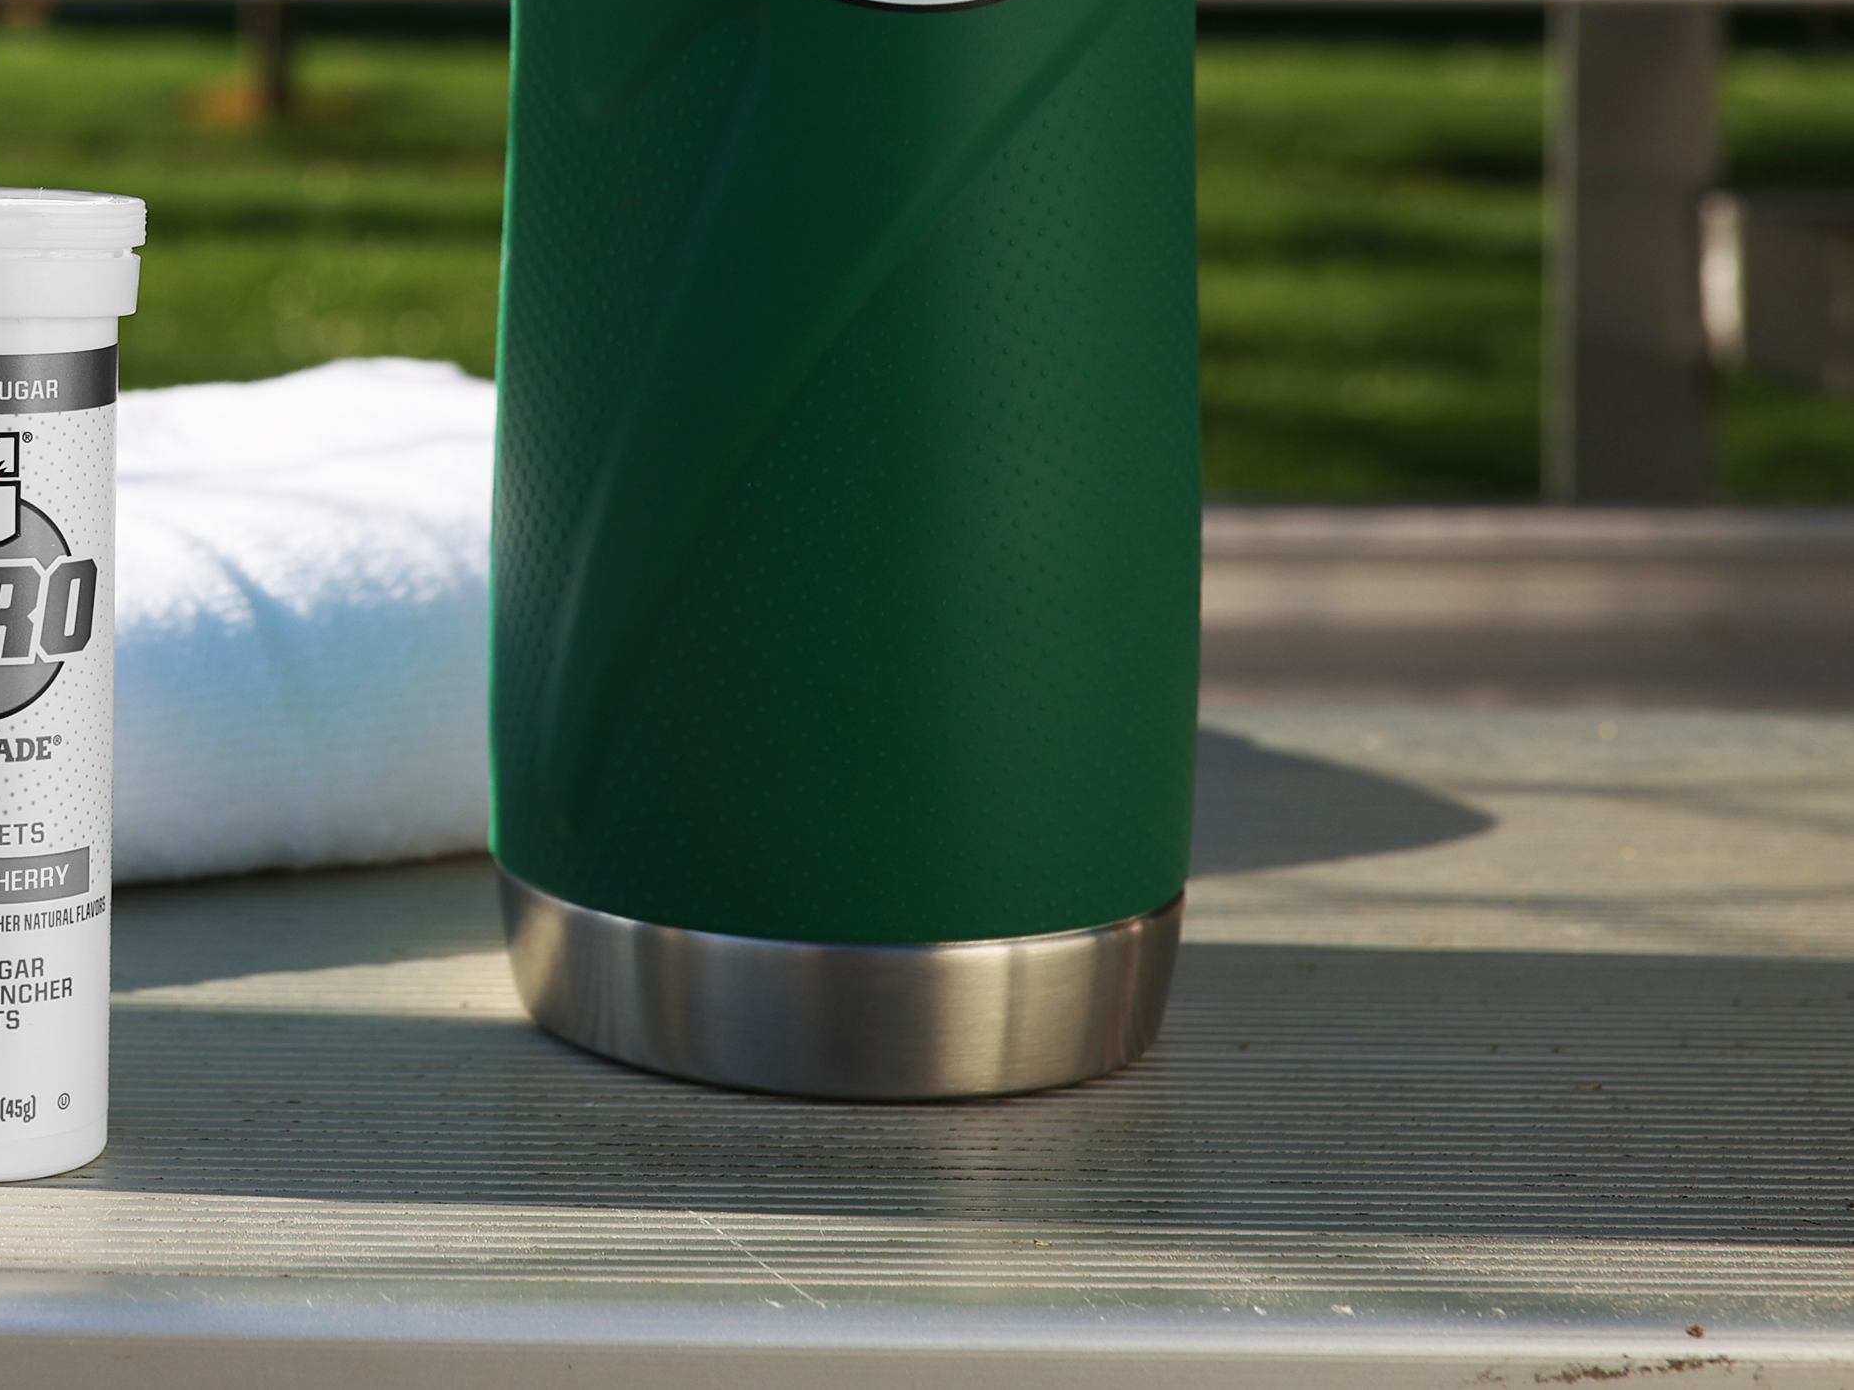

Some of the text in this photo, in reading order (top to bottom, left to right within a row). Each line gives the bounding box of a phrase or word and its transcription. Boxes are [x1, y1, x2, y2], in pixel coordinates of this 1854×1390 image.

[24, 908, 75, 931] NATURAL
[76, 895, 106, 923] FLAVORS
[0, 1095, 36, 1123] (45g)
